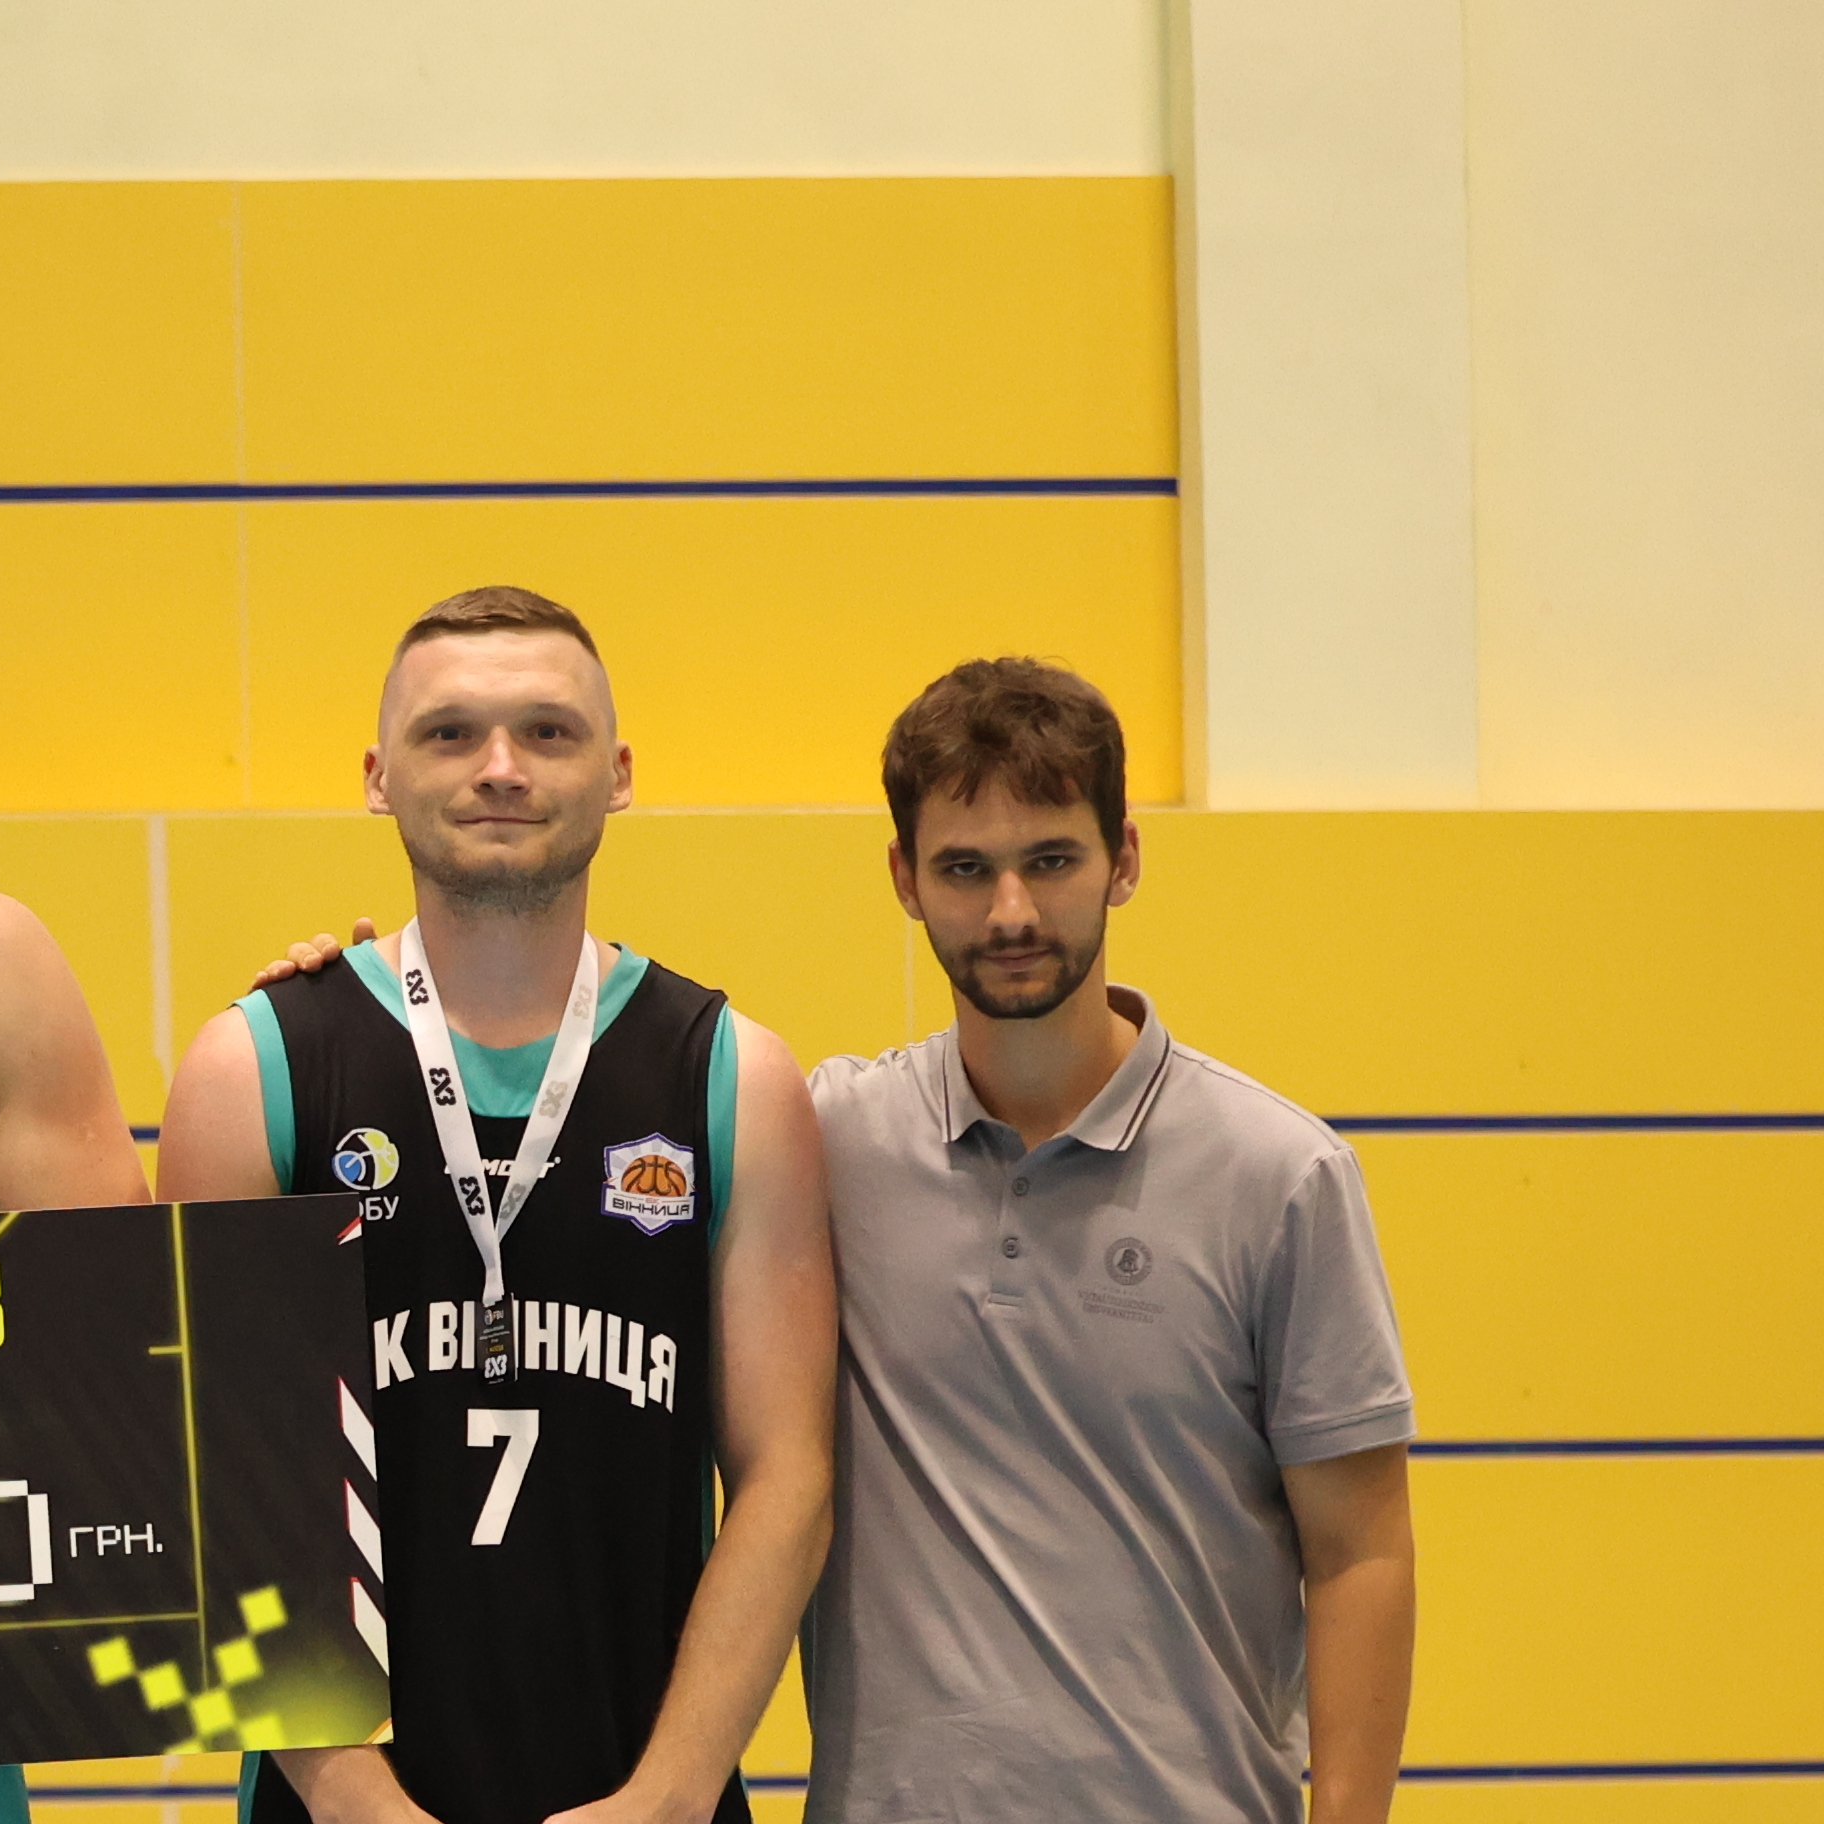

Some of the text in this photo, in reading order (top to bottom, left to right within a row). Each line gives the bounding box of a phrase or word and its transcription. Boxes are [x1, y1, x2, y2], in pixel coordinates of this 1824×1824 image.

[359, 1196, 399, 1220] БУ
[612, 1197, 690, 1216] ВІННИЦЯ
[373, 1300, 677, 1414] К ВІНИЦЯ
[467, 1408, 540, 1546] 7
